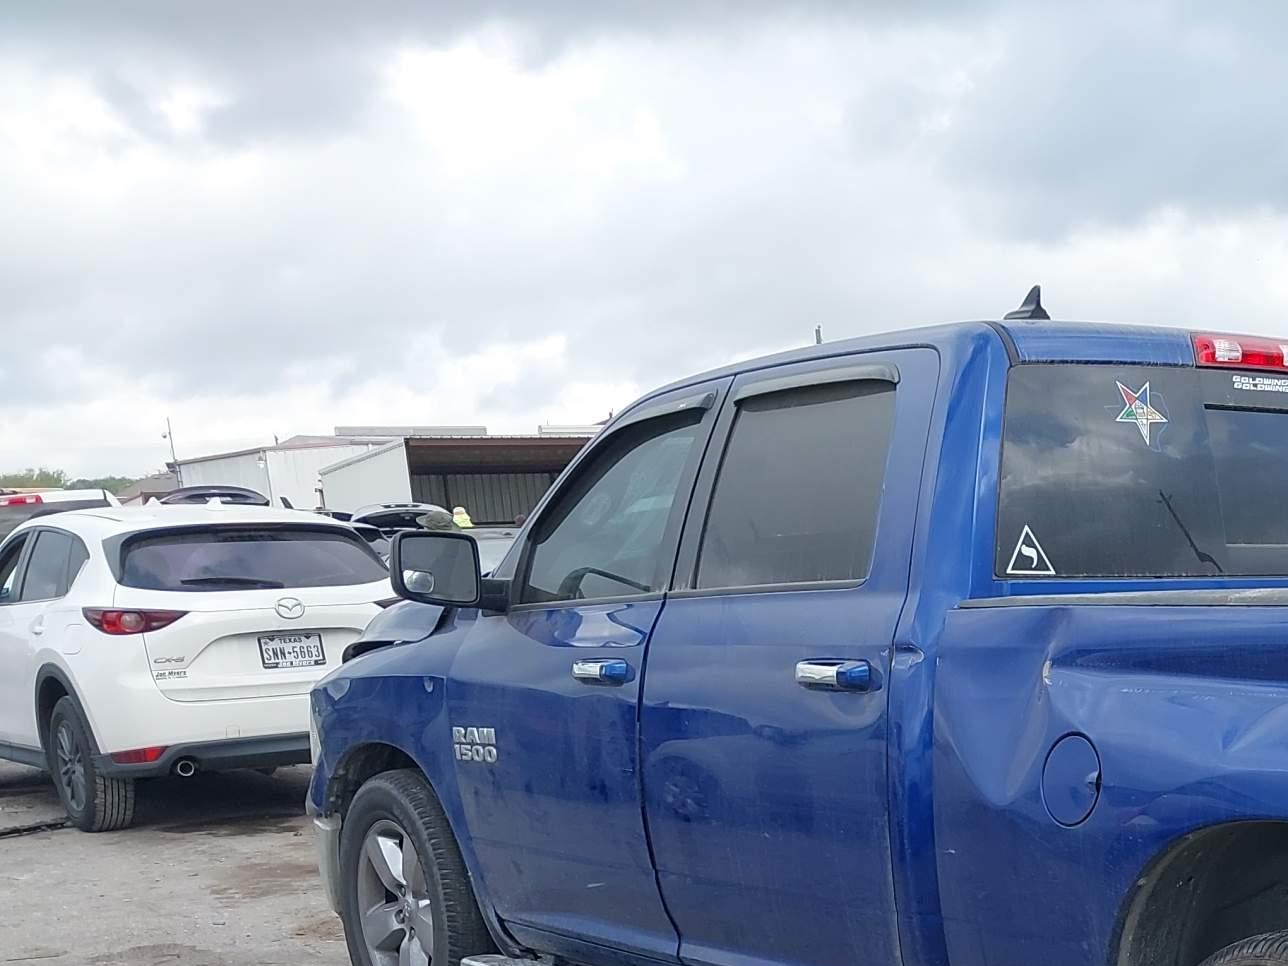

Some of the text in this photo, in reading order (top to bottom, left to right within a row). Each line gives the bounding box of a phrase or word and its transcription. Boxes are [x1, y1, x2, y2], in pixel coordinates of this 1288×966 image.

[1232, 375, 1288, 386] GOLDWING
[279, 637, 303, 645] TEXAS
[452, 726, 496, 744] RAM
[453, 744, 498, 763] 1500
